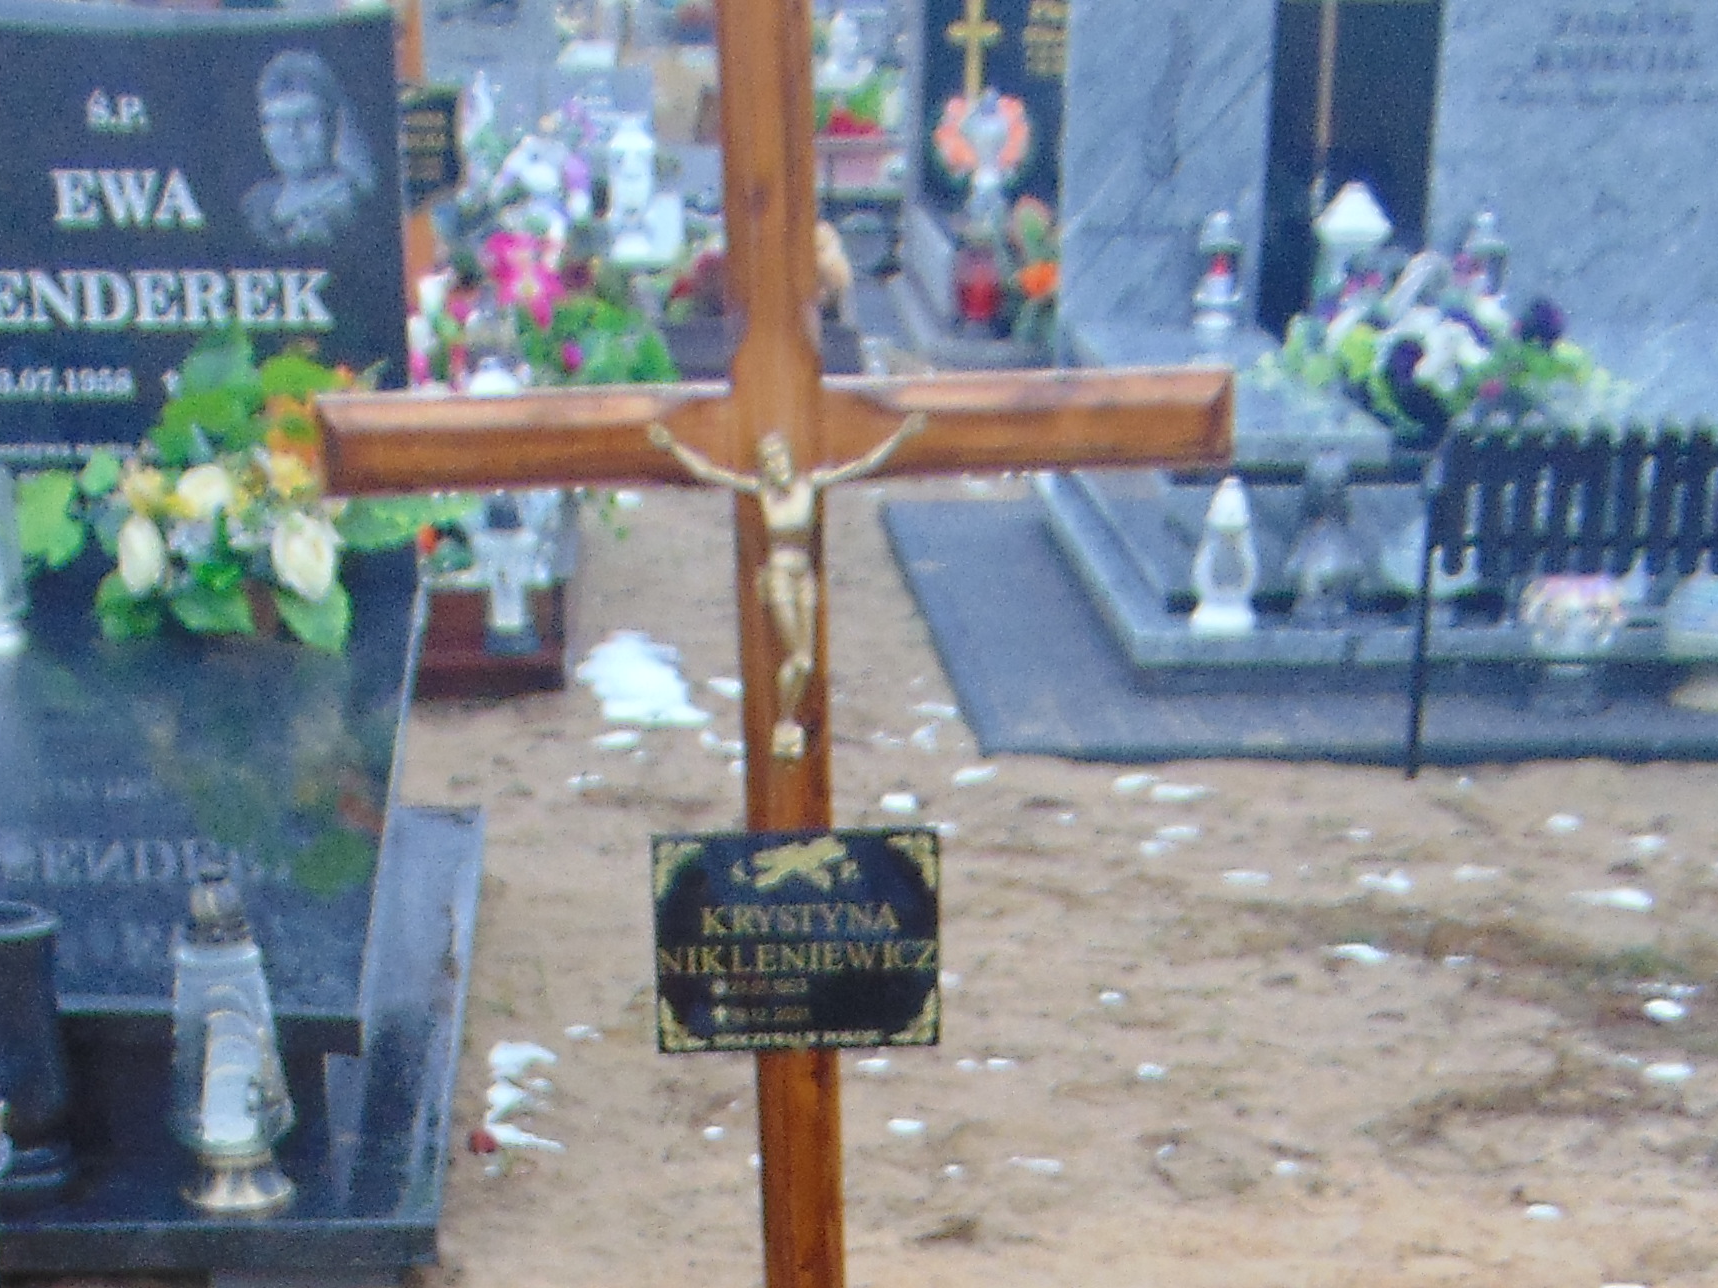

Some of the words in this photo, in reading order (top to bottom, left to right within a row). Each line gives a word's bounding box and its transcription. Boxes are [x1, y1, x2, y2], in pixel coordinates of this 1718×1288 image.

[51, 168, 207, 228] EWA
[700, 902, 900, 936] KRYSTYNA
[659, 939, 937, 974] NIKLENIEWICZ
